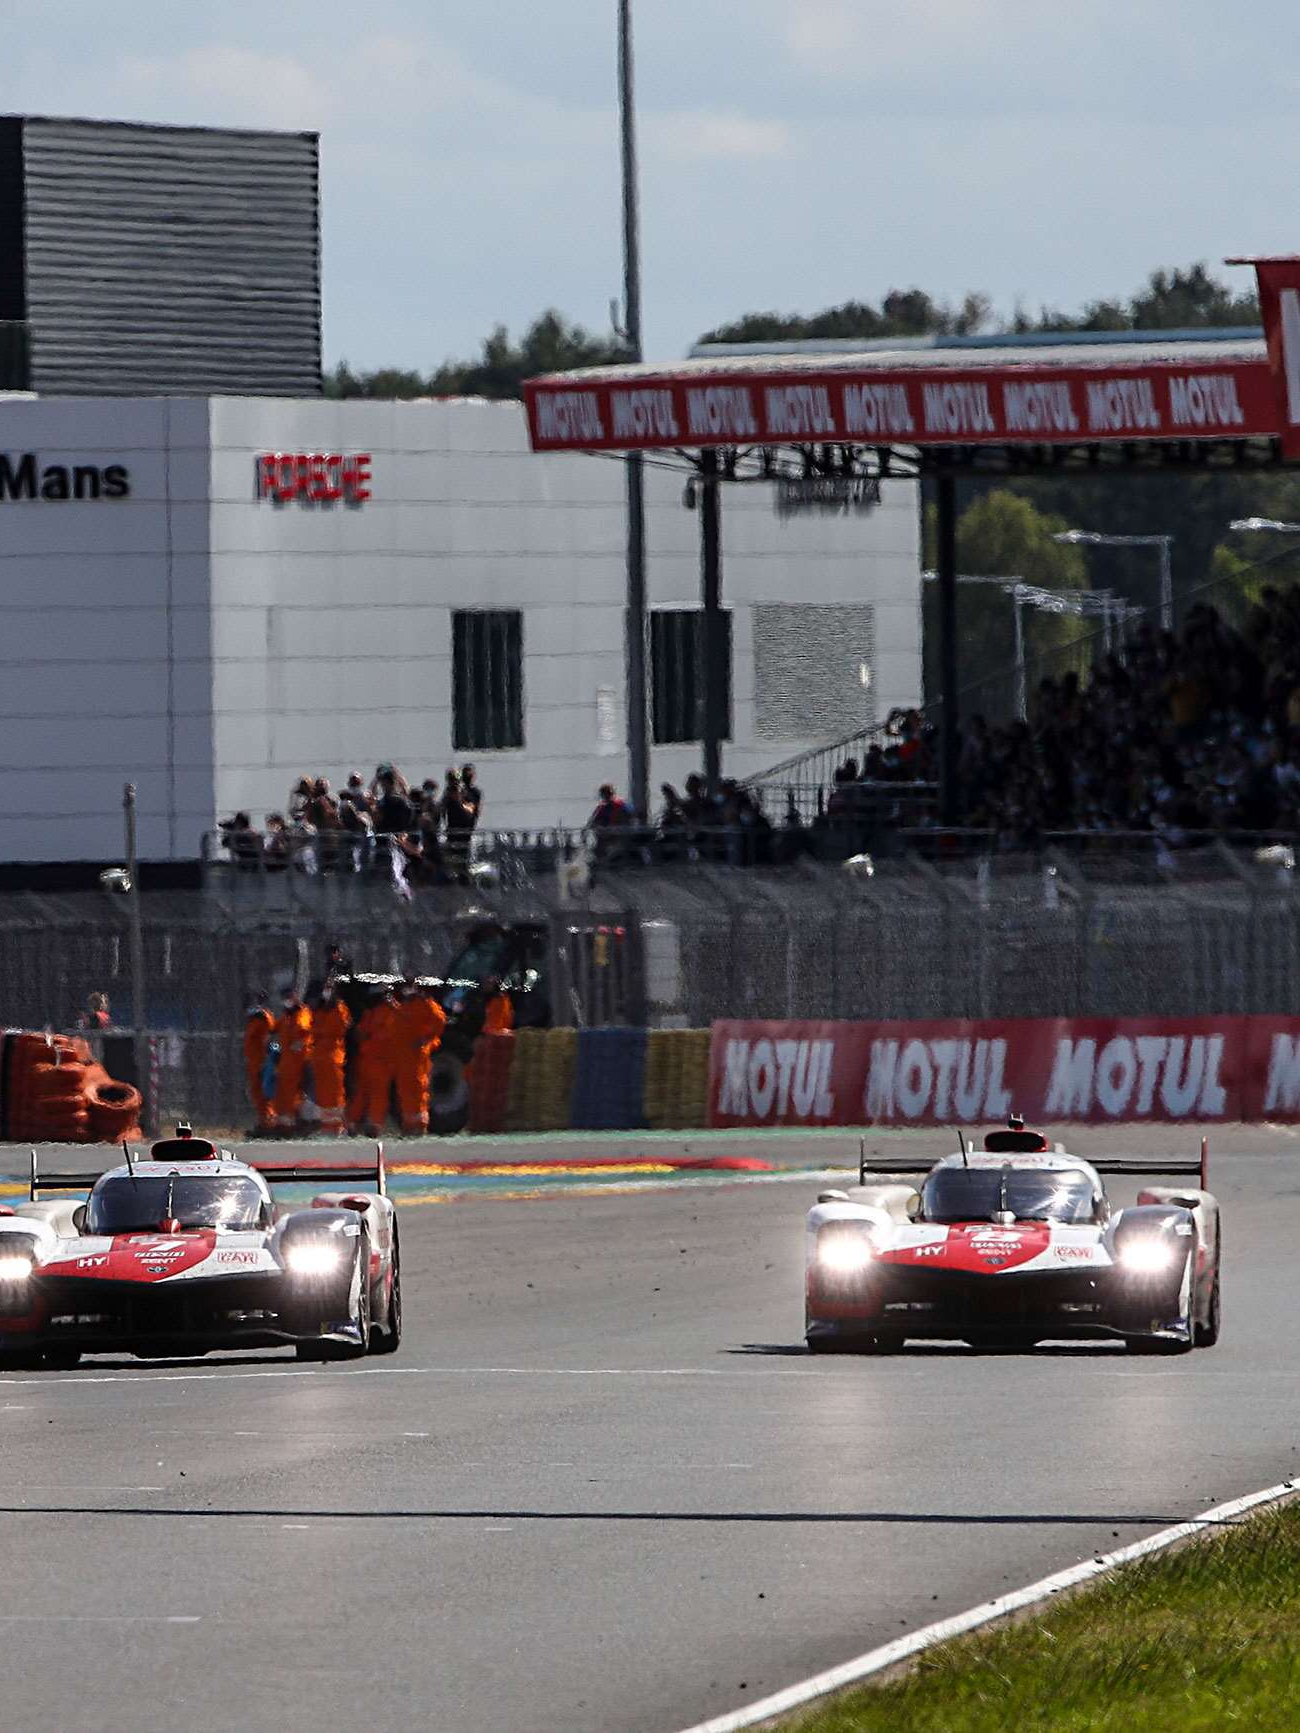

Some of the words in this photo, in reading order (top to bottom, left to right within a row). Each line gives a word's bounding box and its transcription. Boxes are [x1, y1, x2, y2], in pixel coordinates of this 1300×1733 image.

[611, 389, 679, 438] MOTUL
[686, 386, 757, 435] MOTUL
[765, 385, 835, 433] MOTUL
[842, 383, 914, 432] MOTUL
[922, 382, 995, 432] MOTUL
[1003, 381, 1079, 431] MOTUL
[1086, 378, 1161, 430] MOTUL
[1168, 374, 1244, 425] MOTUL
[718, 1038, 835, 1118] MOTUL
[865, 1037, 1012, 1120] MOTUL
[1045, 1033, 1227, 1116] MOTUL
[79, 1256, 108, 1268] HY
[915, 1246, 944, 1257] HY
